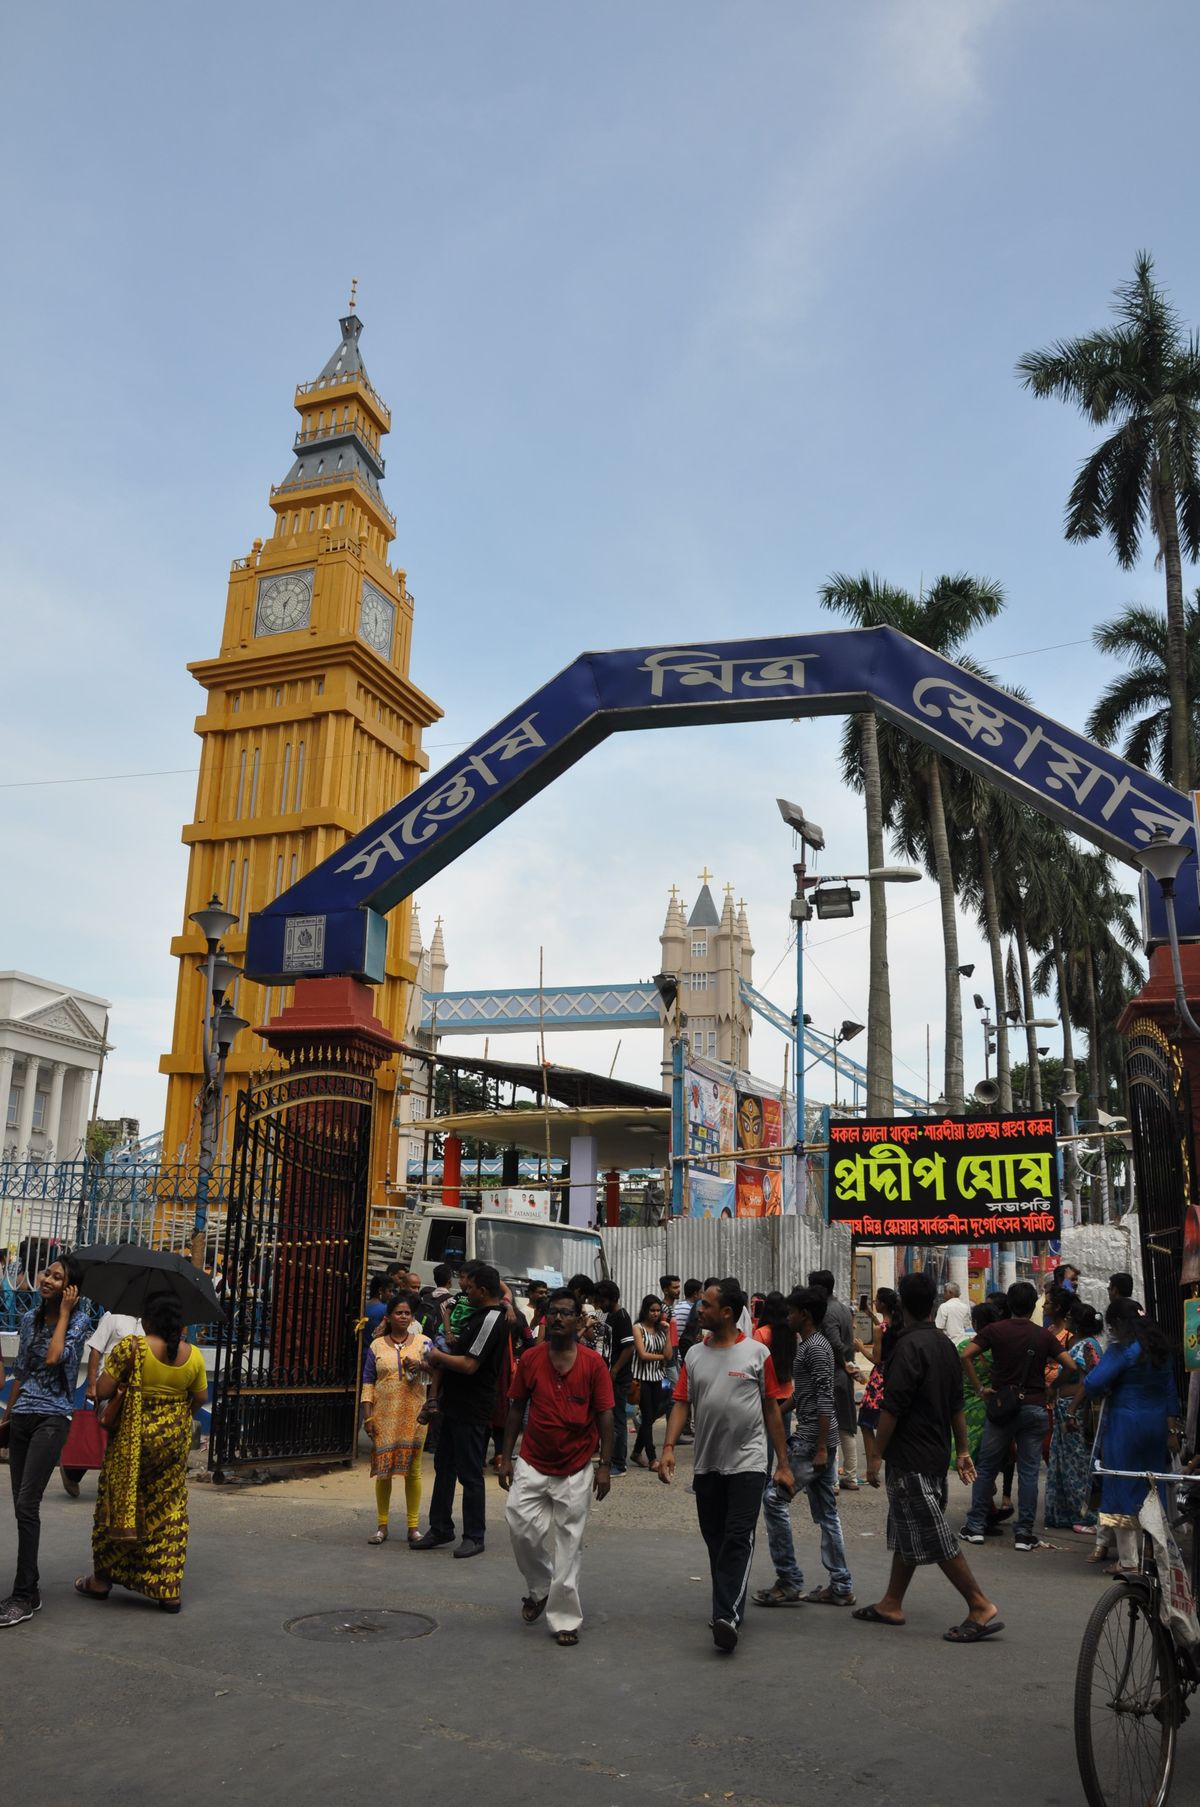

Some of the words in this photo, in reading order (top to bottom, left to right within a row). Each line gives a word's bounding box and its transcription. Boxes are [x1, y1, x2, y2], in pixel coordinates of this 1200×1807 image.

[334, 711, 547, 881] সন্তোষ
[637, 650, 820, 698] মিত্র
[912, 677, 1193, 846] স্কোয়ার
[831, 1126, 861, 1143] সকলে
[861, 1125, 888, 1143] ভালো
[889, 1125, 918, 1145] থাকুন
[923, 1119, 966, 1142] শারদীয়া
[966, 1122, 1000, 1140] শুভেচ্ছা
[1001, 1120, 1026, 1138] গ্রহণ
[1027, 1119, 1053, 1136] করুন
[834, 1143, 947, 1202] প্রদীপ
[956, 1152, 1054, 1200] ঘোষ
[985, 1197, 1051, 1213] সভাপতি
[863, 1214, 882, 1235] মিত্র
[883, 1218, 918, 1236] স্কোয়ার
[919, 1213, 969, 1237] সার্বজনীন
[969, 1214, 1020, 1238] দুর্গোৎসব
[1021, 1212, 1055, 1233] সমিতি
